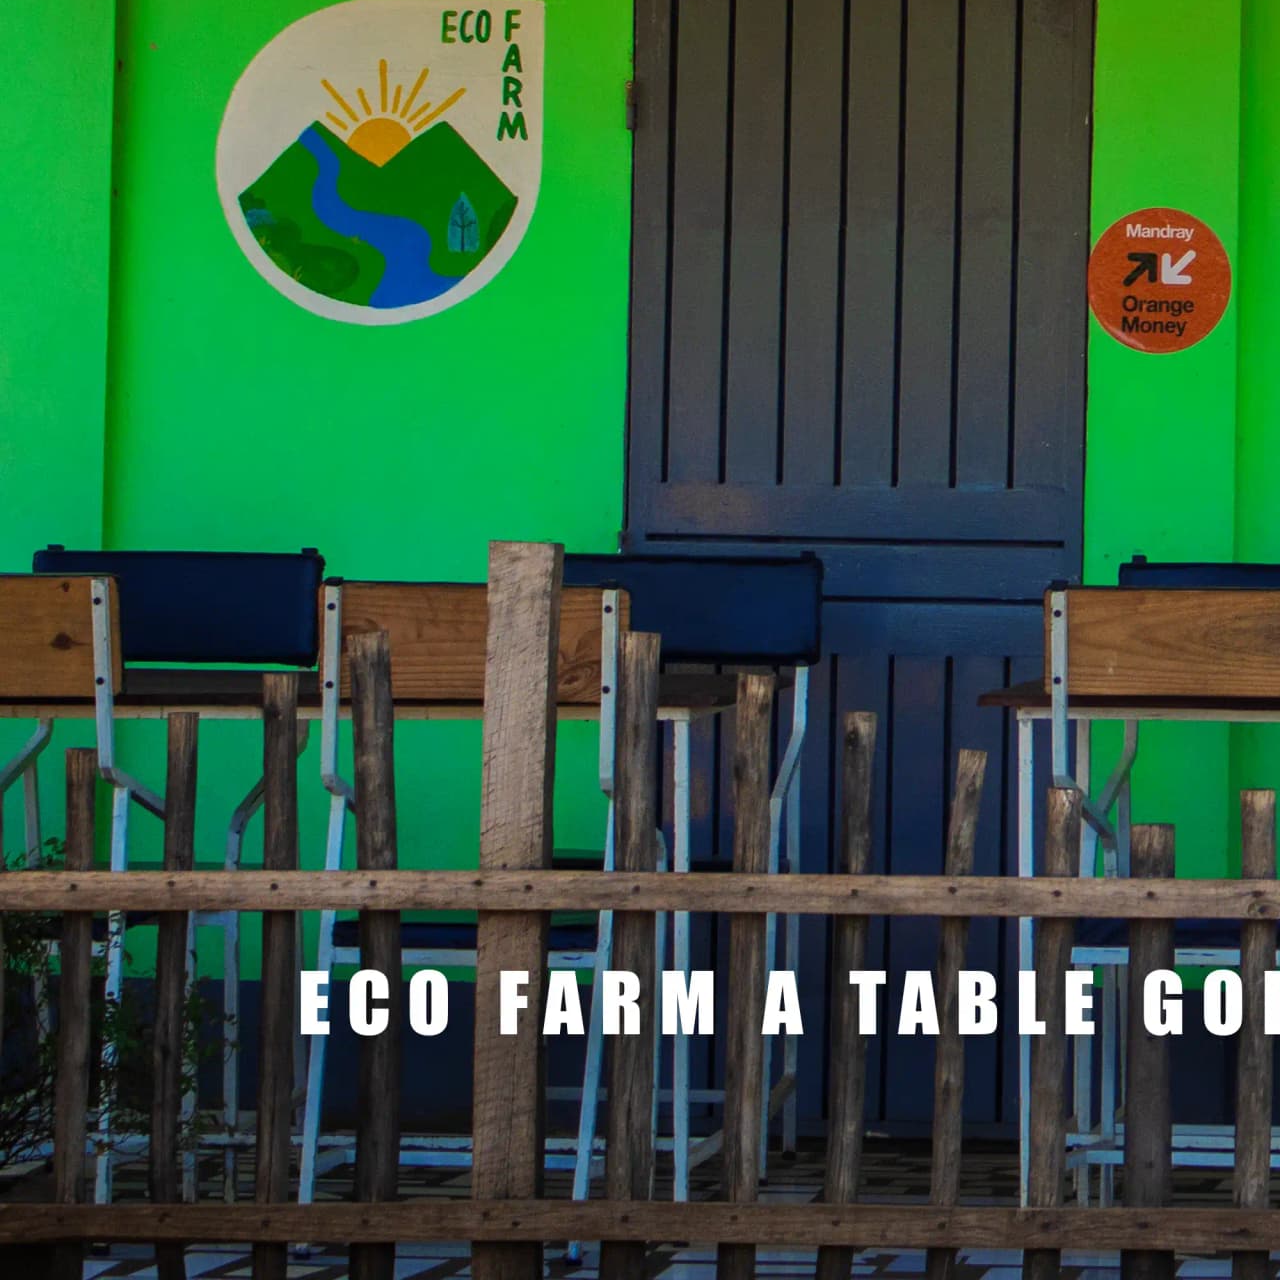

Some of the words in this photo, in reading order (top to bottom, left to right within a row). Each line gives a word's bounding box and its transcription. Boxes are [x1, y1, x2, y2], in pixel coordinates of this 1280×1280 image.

[441, 9, 492, 43] ECO
[497, 9, 529, 141] FARM
[1125, 223, 1195, 242] Mandray
[1122, 295, 1195, 317] Orange
[1121, 316, 1188, 337] Money
